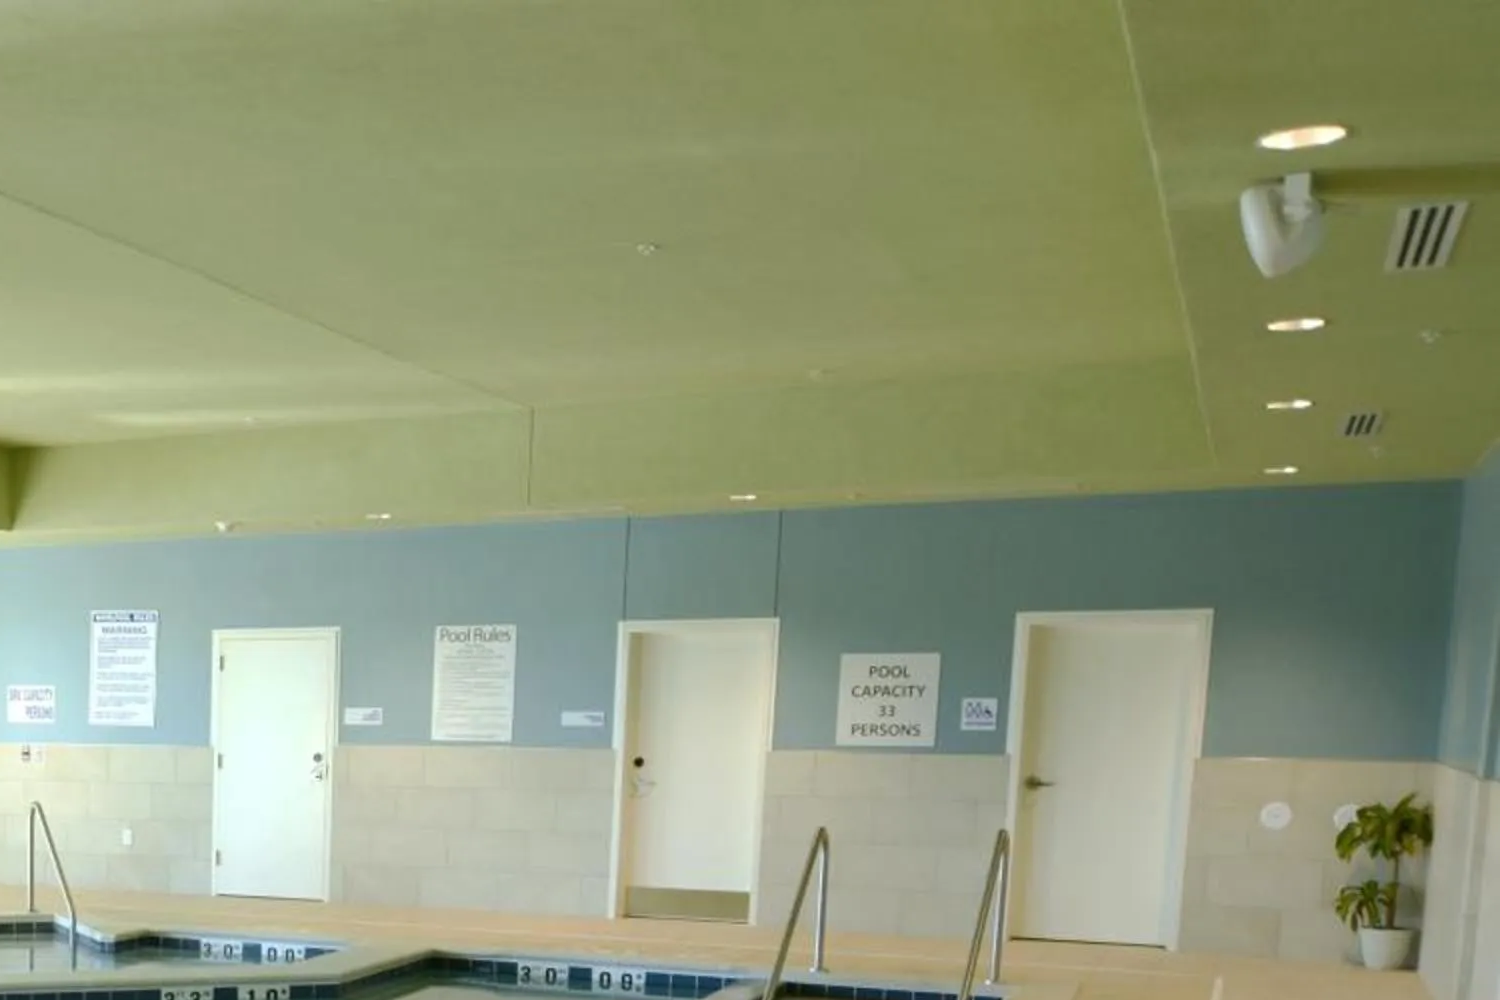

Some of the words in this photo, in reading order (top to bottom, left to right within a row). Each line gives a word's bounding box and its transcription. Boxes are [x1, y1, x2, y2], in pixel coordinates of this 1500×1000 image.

[440, 626, 471, 643] Pool
[473, 626, 512, 643] Rules
[868, 664, 911, 679] POOL
[851, 685, 927, 699] CAPACITY
[877, 705, 897, 718] 33
[850, 723, 922, 738] PERSONS
